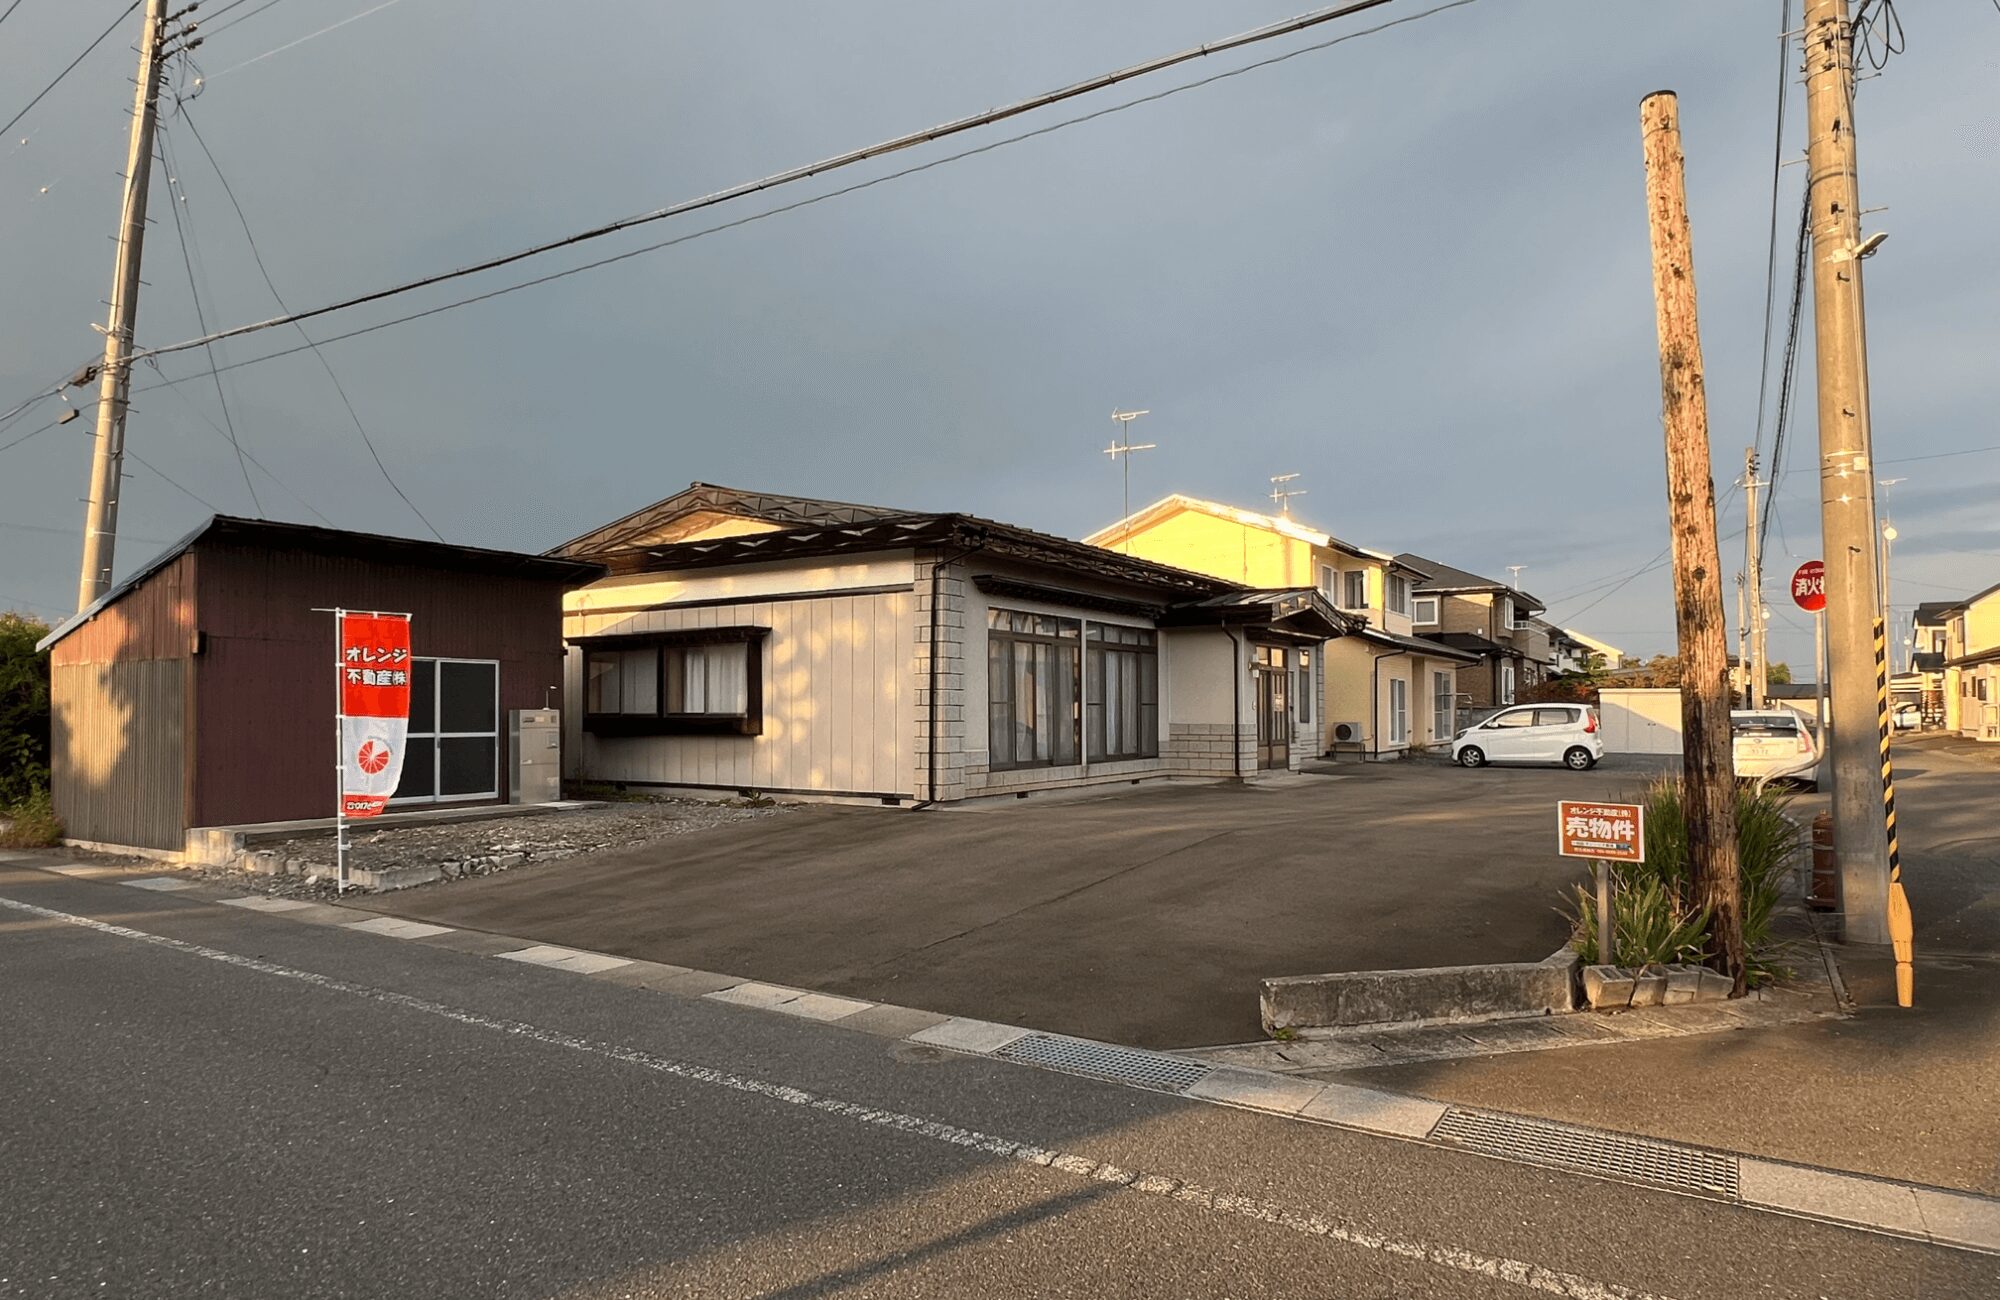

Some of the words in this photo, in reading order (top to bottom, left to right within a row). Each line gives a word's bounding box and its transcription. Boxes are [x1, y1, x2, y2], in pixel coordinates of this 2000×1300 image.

[346, 647, 407, 663] オレンジ
[1566, 817, 1635, 841] 売物件
